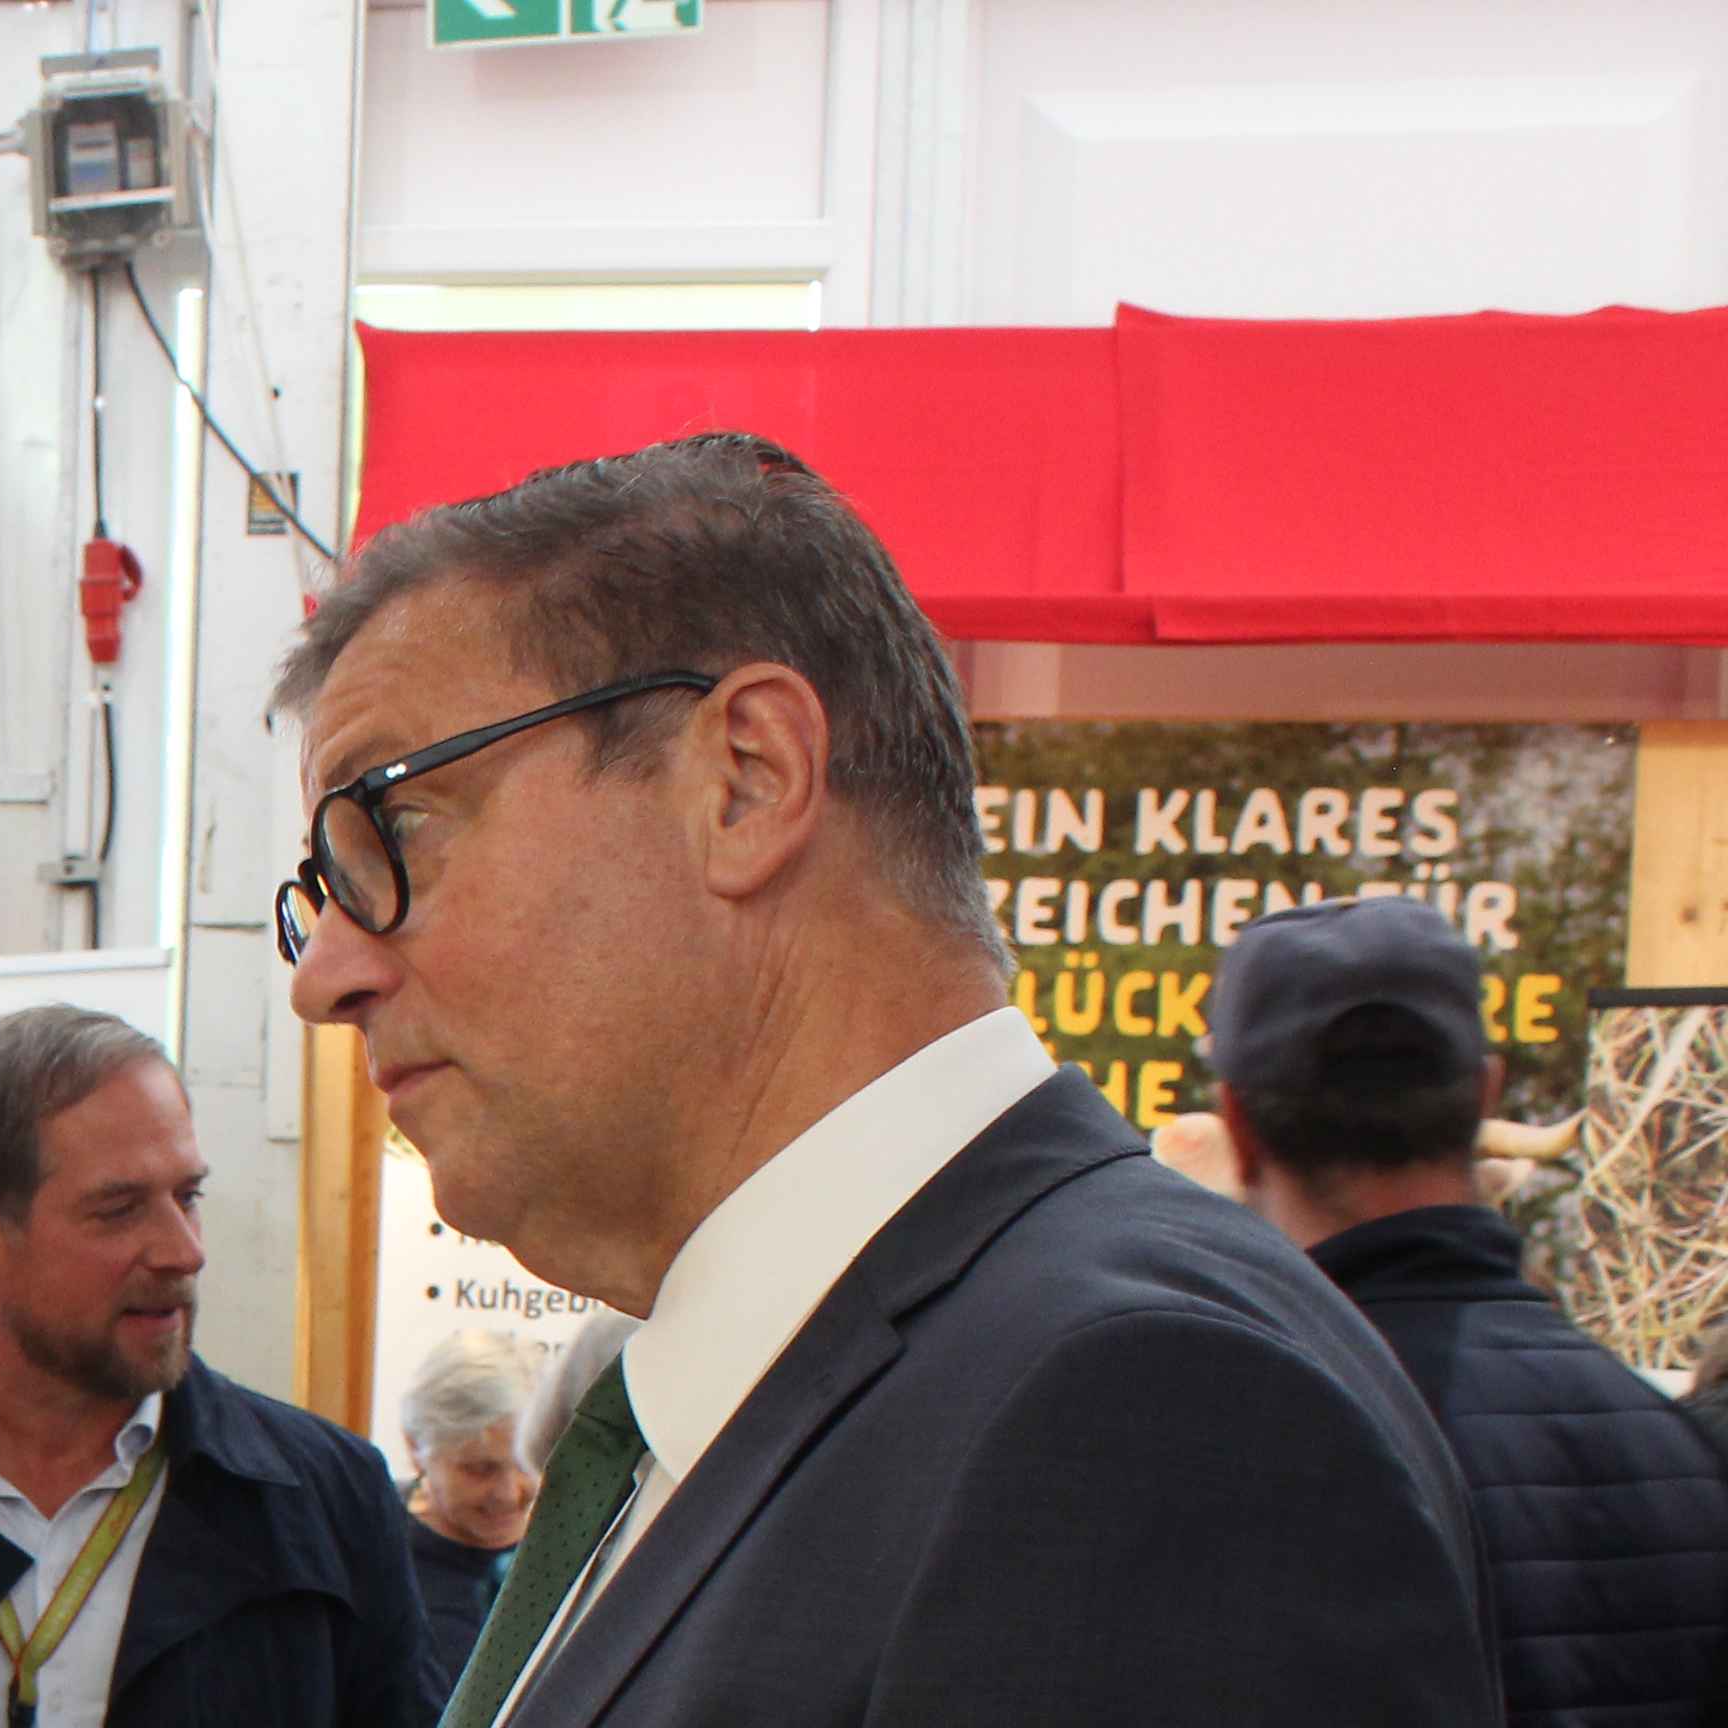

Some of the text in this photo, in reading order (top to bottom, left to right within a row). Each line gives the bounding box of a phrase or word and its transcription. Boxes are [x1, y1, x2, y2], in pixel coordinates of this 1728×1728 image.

[974, 785, 1459, 858] EIN KLARES
[1014, 950, 1213, 1038] LÜCK
